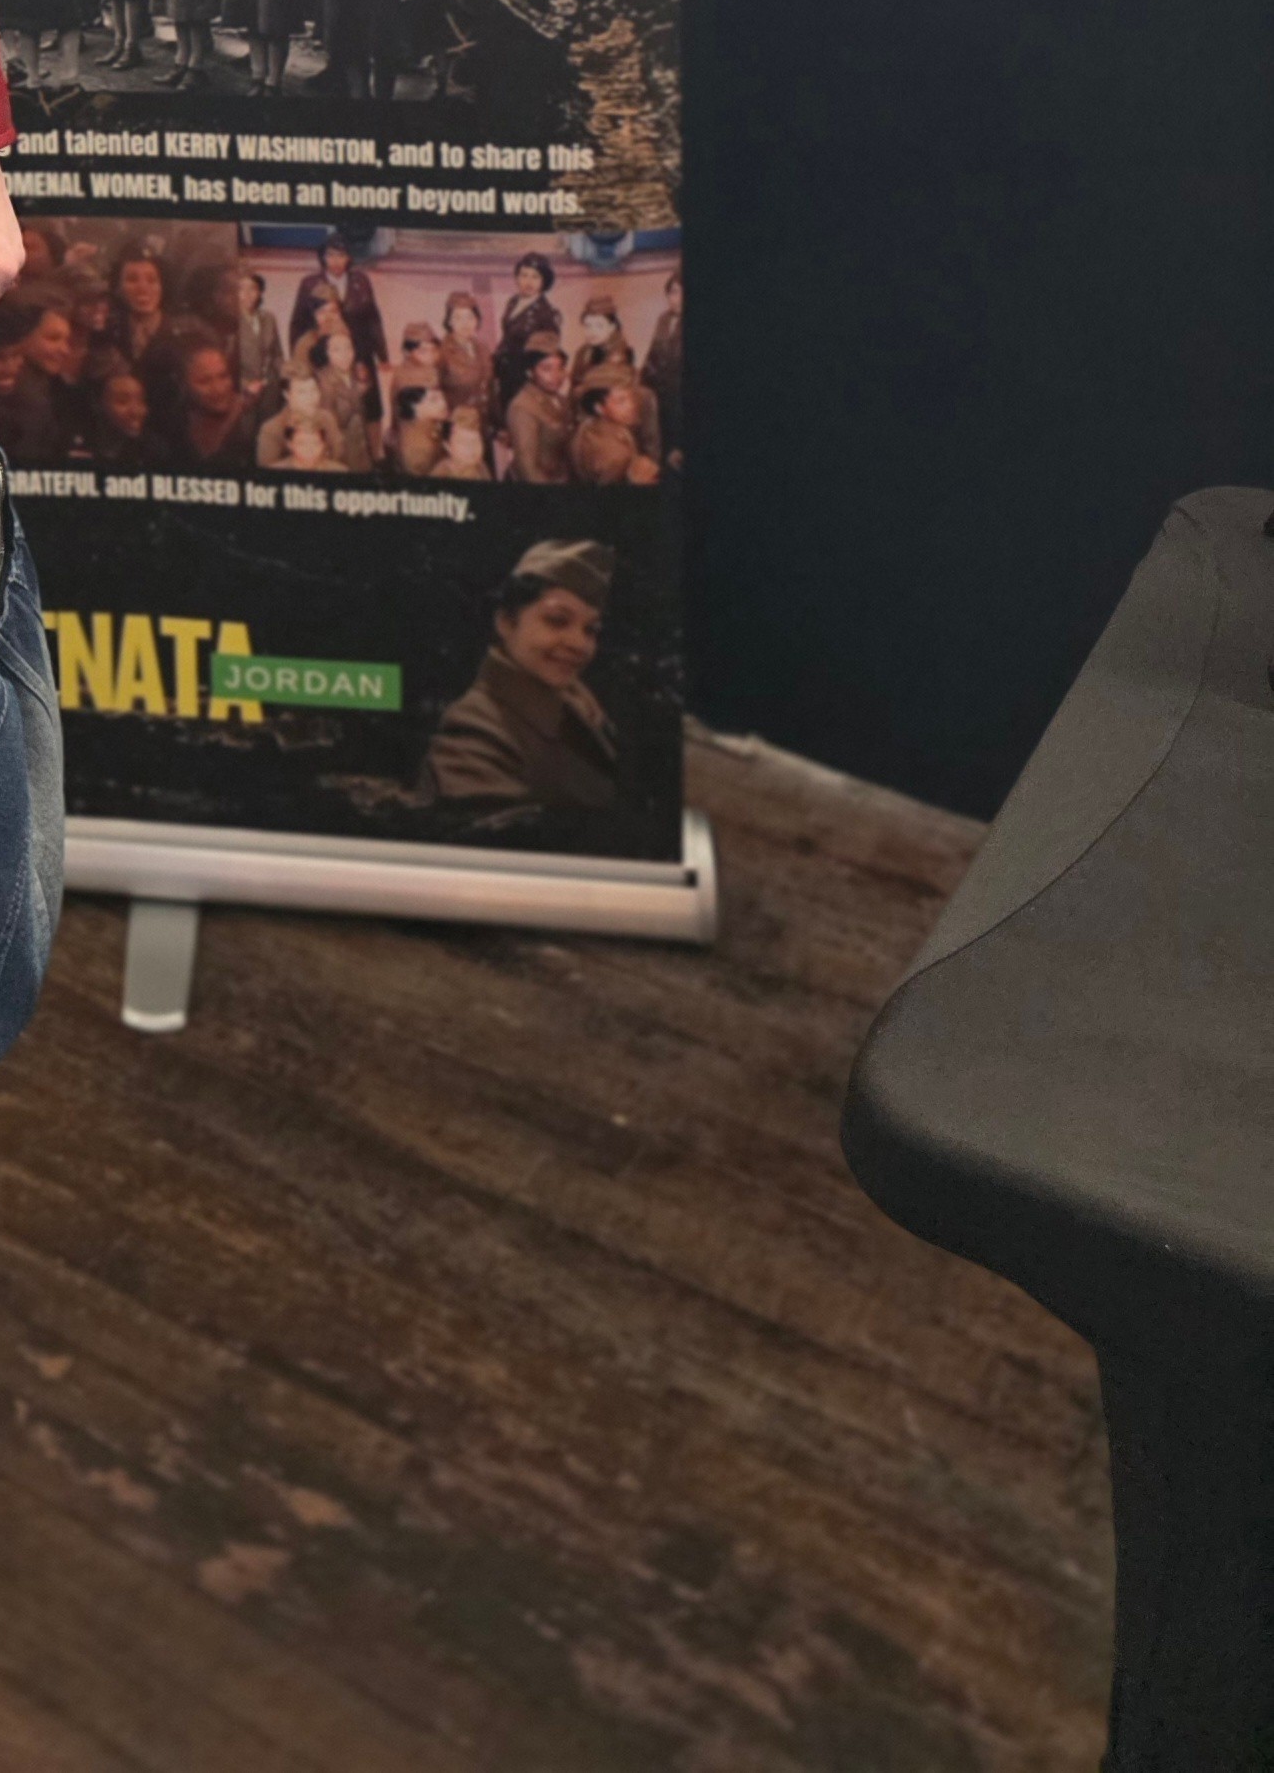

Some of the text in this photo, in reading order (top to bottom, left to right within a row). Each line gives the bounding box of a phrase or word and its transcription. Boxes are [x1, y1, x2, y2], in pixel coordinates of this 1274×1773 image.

[16, 128, 59, 155] and
[63, 128, 159, 156] talented
[163, 131, 230, 159] KERRY
[235, 133, 382, 168] WASHINGTON,
[388, 140, 434, 167] and
[439, 141, 465, 169] to
[470, 142, 541, 171] share
[546, 142, 595, 172] this
[89, 171, 585, 215] WOMEN, has been an honor beyond words.
[104, 473, 474, 522] and BLESSED for this opportunity.
[224, 664, 384, 699] JORDAN
